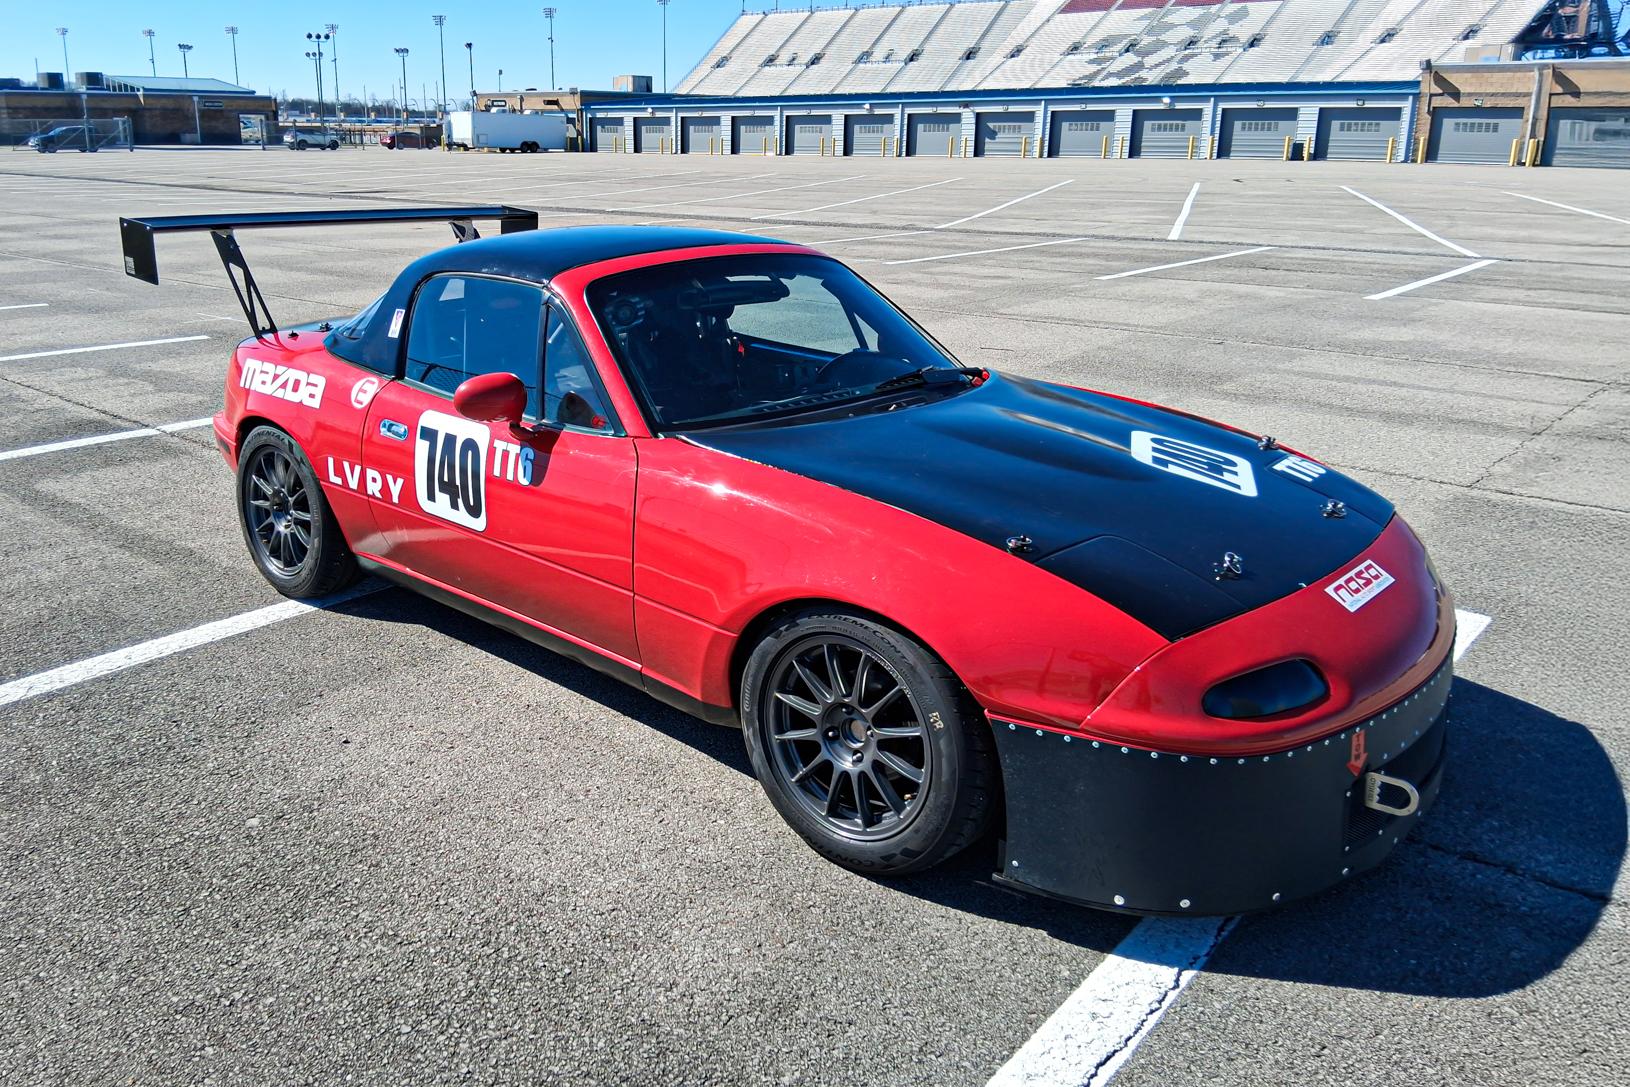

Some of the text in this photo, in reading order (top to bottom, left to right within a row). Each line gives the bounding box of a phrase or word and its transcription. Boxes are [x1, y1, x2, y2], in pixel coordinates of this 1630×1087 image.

[353, 378, 377, 406] E
[327, 456, 404, 504] LVRY
[420, 426, 483, 519] 740
[493, 438, 535, 487] TT6
[1150, 437, 1243, 491] 740
[1333, 563, 1384, 603] nasa
